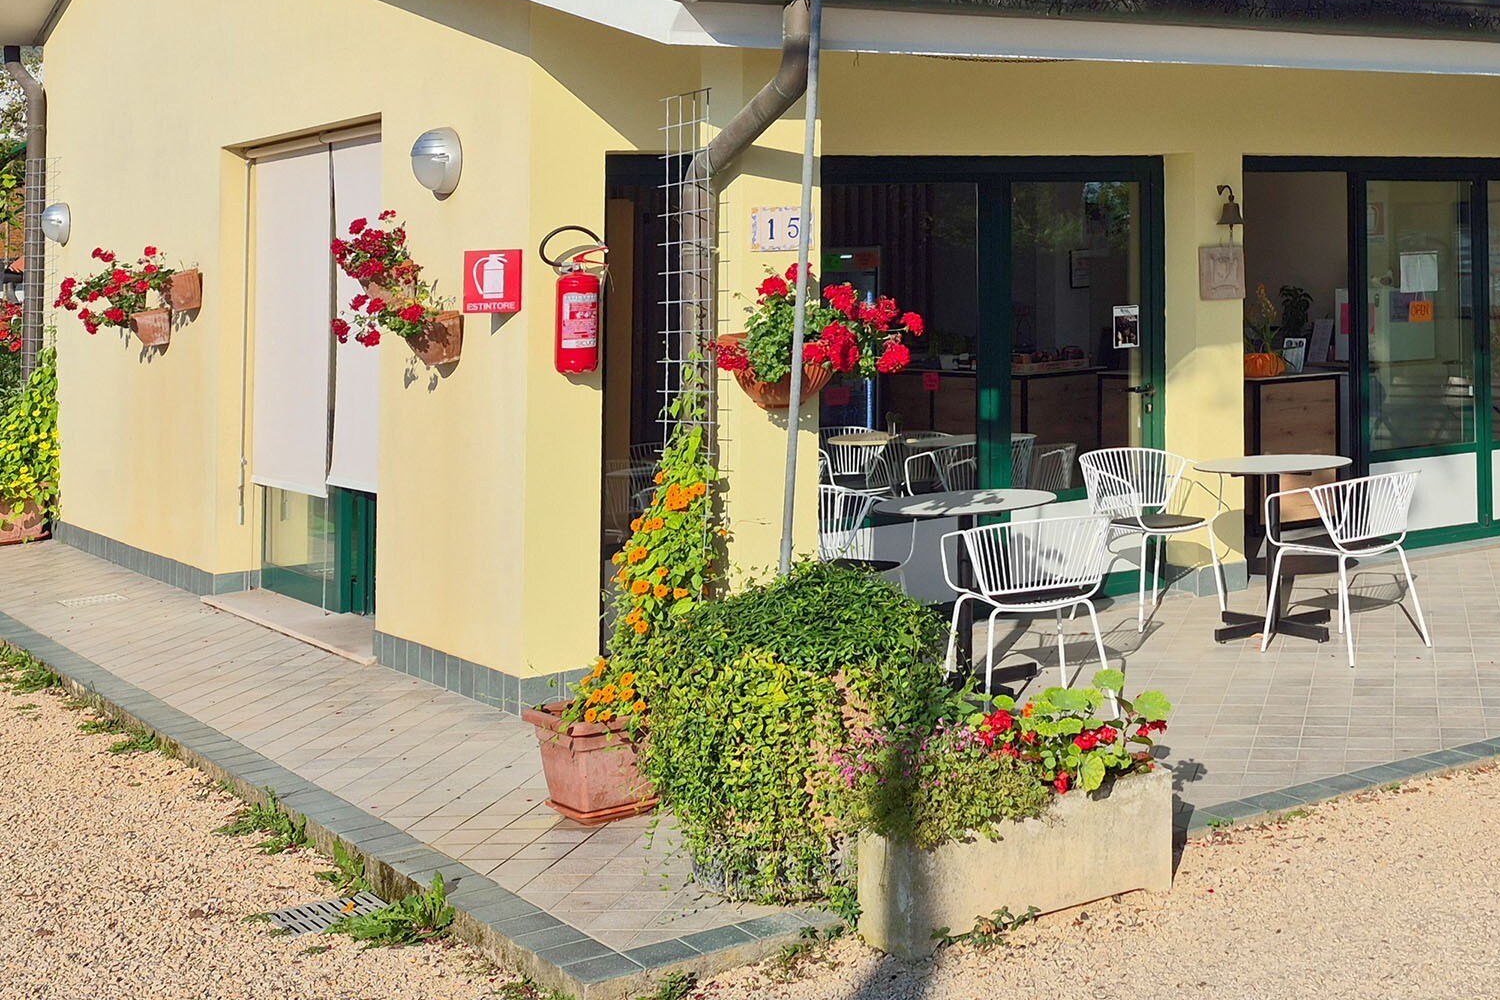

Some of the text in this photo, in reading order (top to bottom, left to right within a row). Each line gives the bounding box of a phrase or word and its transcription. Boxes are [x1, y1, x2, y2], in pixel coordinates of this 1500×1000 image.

[767, 217, 800, 240] 15
[466, 301, 516, 311] ESTINTORE
[1411, 303, 1430, 317] OPEN
